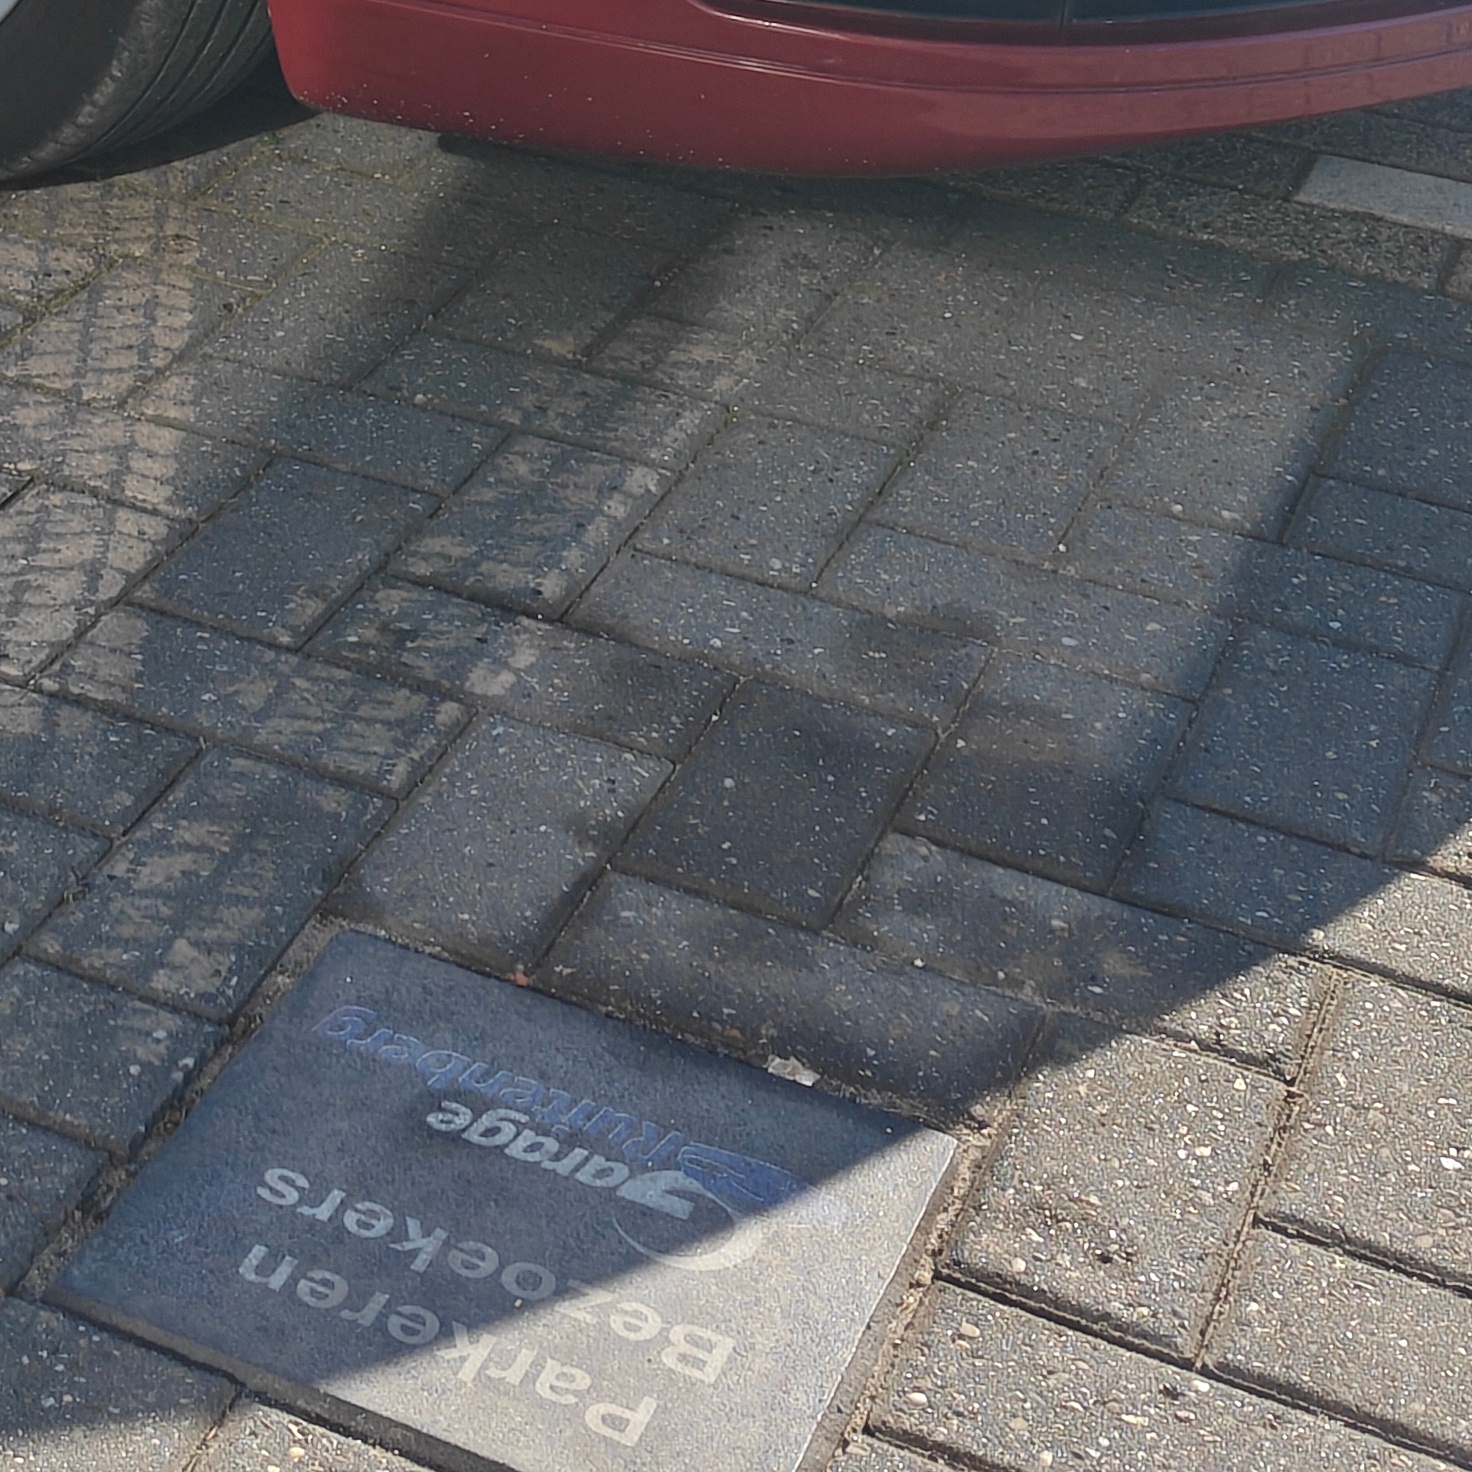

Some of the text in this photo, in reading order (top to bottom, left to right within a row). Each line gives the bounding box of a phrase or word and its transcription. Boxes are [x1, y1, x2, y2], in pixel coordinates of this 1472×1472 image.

[311, 1005, 684, 1163] Ruitenberg
[256, 1165, 740, 1386] Bezoekers
[426, 1099, 766, 1271] Garage
[237, 1242, 659, 1448] Parkeren
